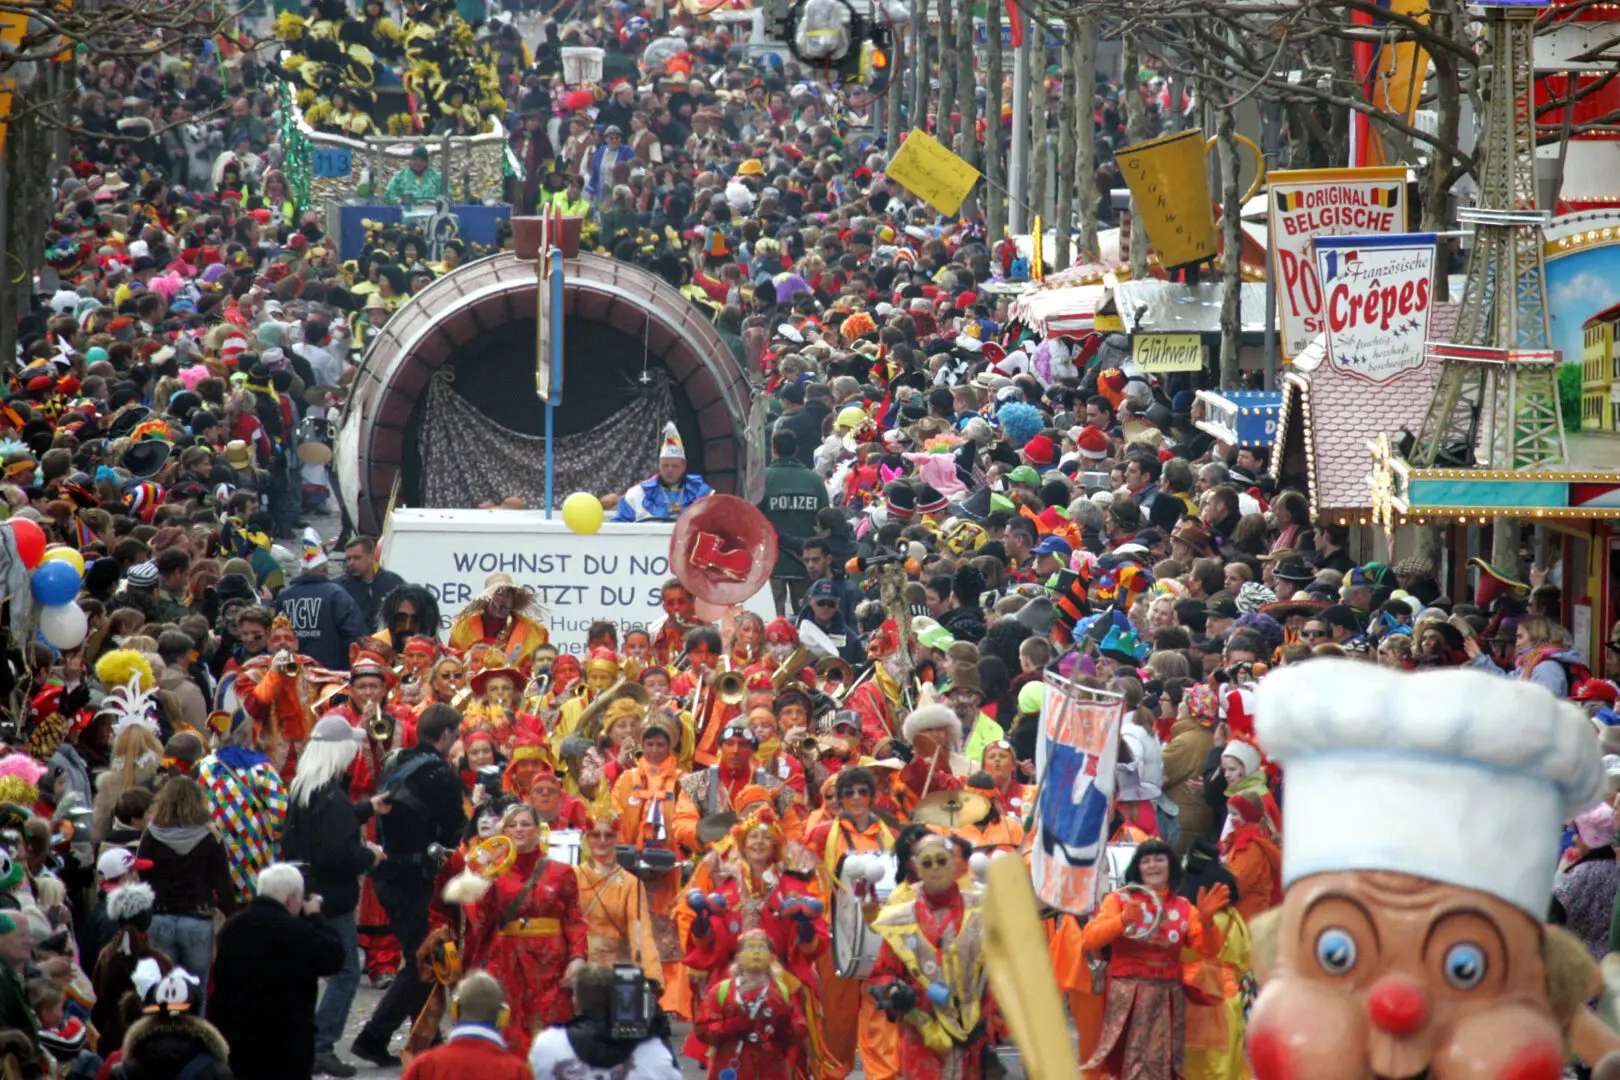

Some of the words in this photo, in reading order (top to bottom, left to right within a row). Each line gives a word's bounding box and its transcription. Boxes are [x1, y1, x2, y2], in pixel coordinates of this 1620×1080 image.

[1306, 186, 1369, 208] ORIGINAL
[1283, 207, 1394, 235] BELGISCHE
[1346, 252, 1429, 283] Französische
[1329, 277, 1429, 332] Crêpes
[1136, 335, 1200, 370] Glühwein
[770, 495, 818, 511] POLIZEI
[453, 552, 572, 574] WOHNST
[583, 554, 618, 575] DU
[600, 585, 640, 606] DU
